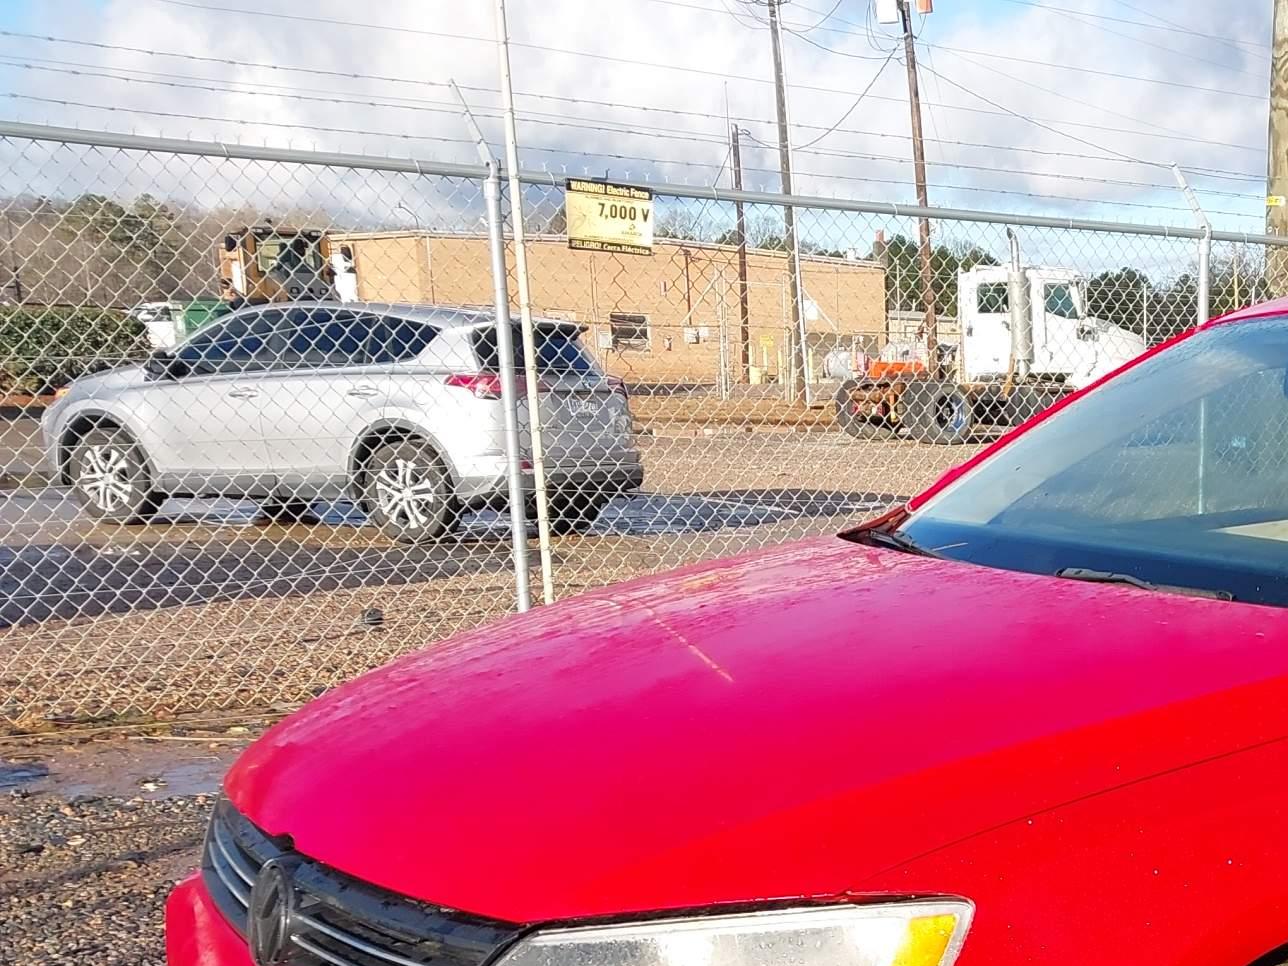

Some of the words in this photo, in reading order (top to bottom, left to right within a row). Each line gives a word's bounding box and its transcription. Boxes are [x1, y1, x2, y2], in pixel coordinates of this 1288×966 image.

[570, 180, 605, 194] WARNING!
[606, 185, 630, 197] Electric
[630, 188, 650, 199] Fence
[598, 202, 637, 221] 7,000
[641, 208, 650, 223] V
